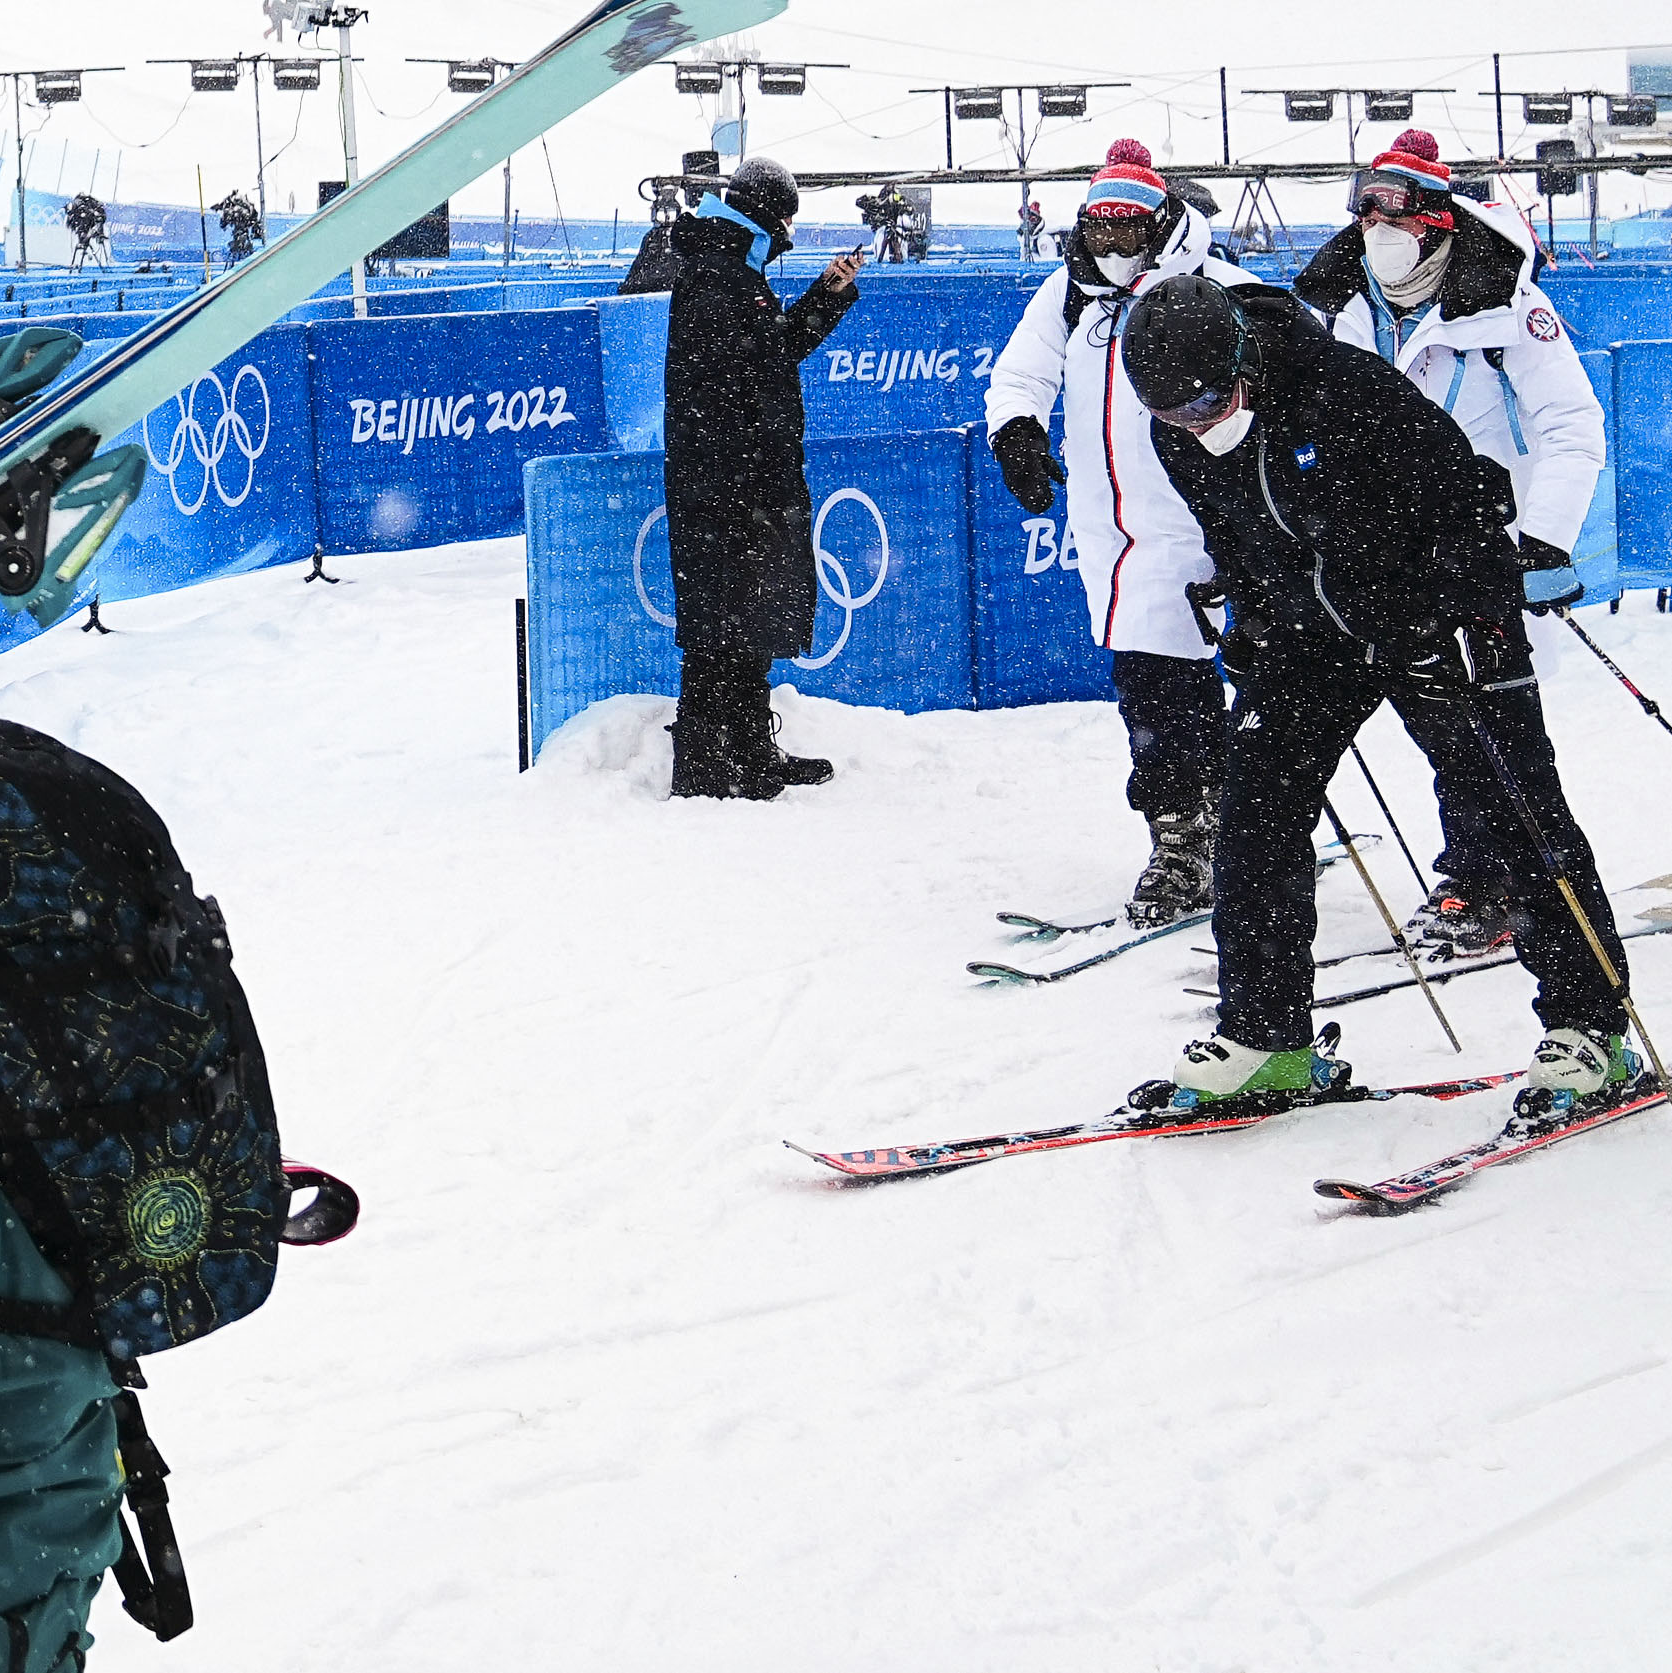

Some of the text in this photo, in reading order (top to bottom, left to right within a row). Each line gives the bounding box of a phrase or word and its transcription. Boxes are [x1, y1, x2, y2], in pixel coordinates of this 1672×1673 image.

[826, 347, 960, 392] BEIJING
[349, 386, 577, 455] BEIJING 2022
[1296, 447, 1317, 465] Rai
